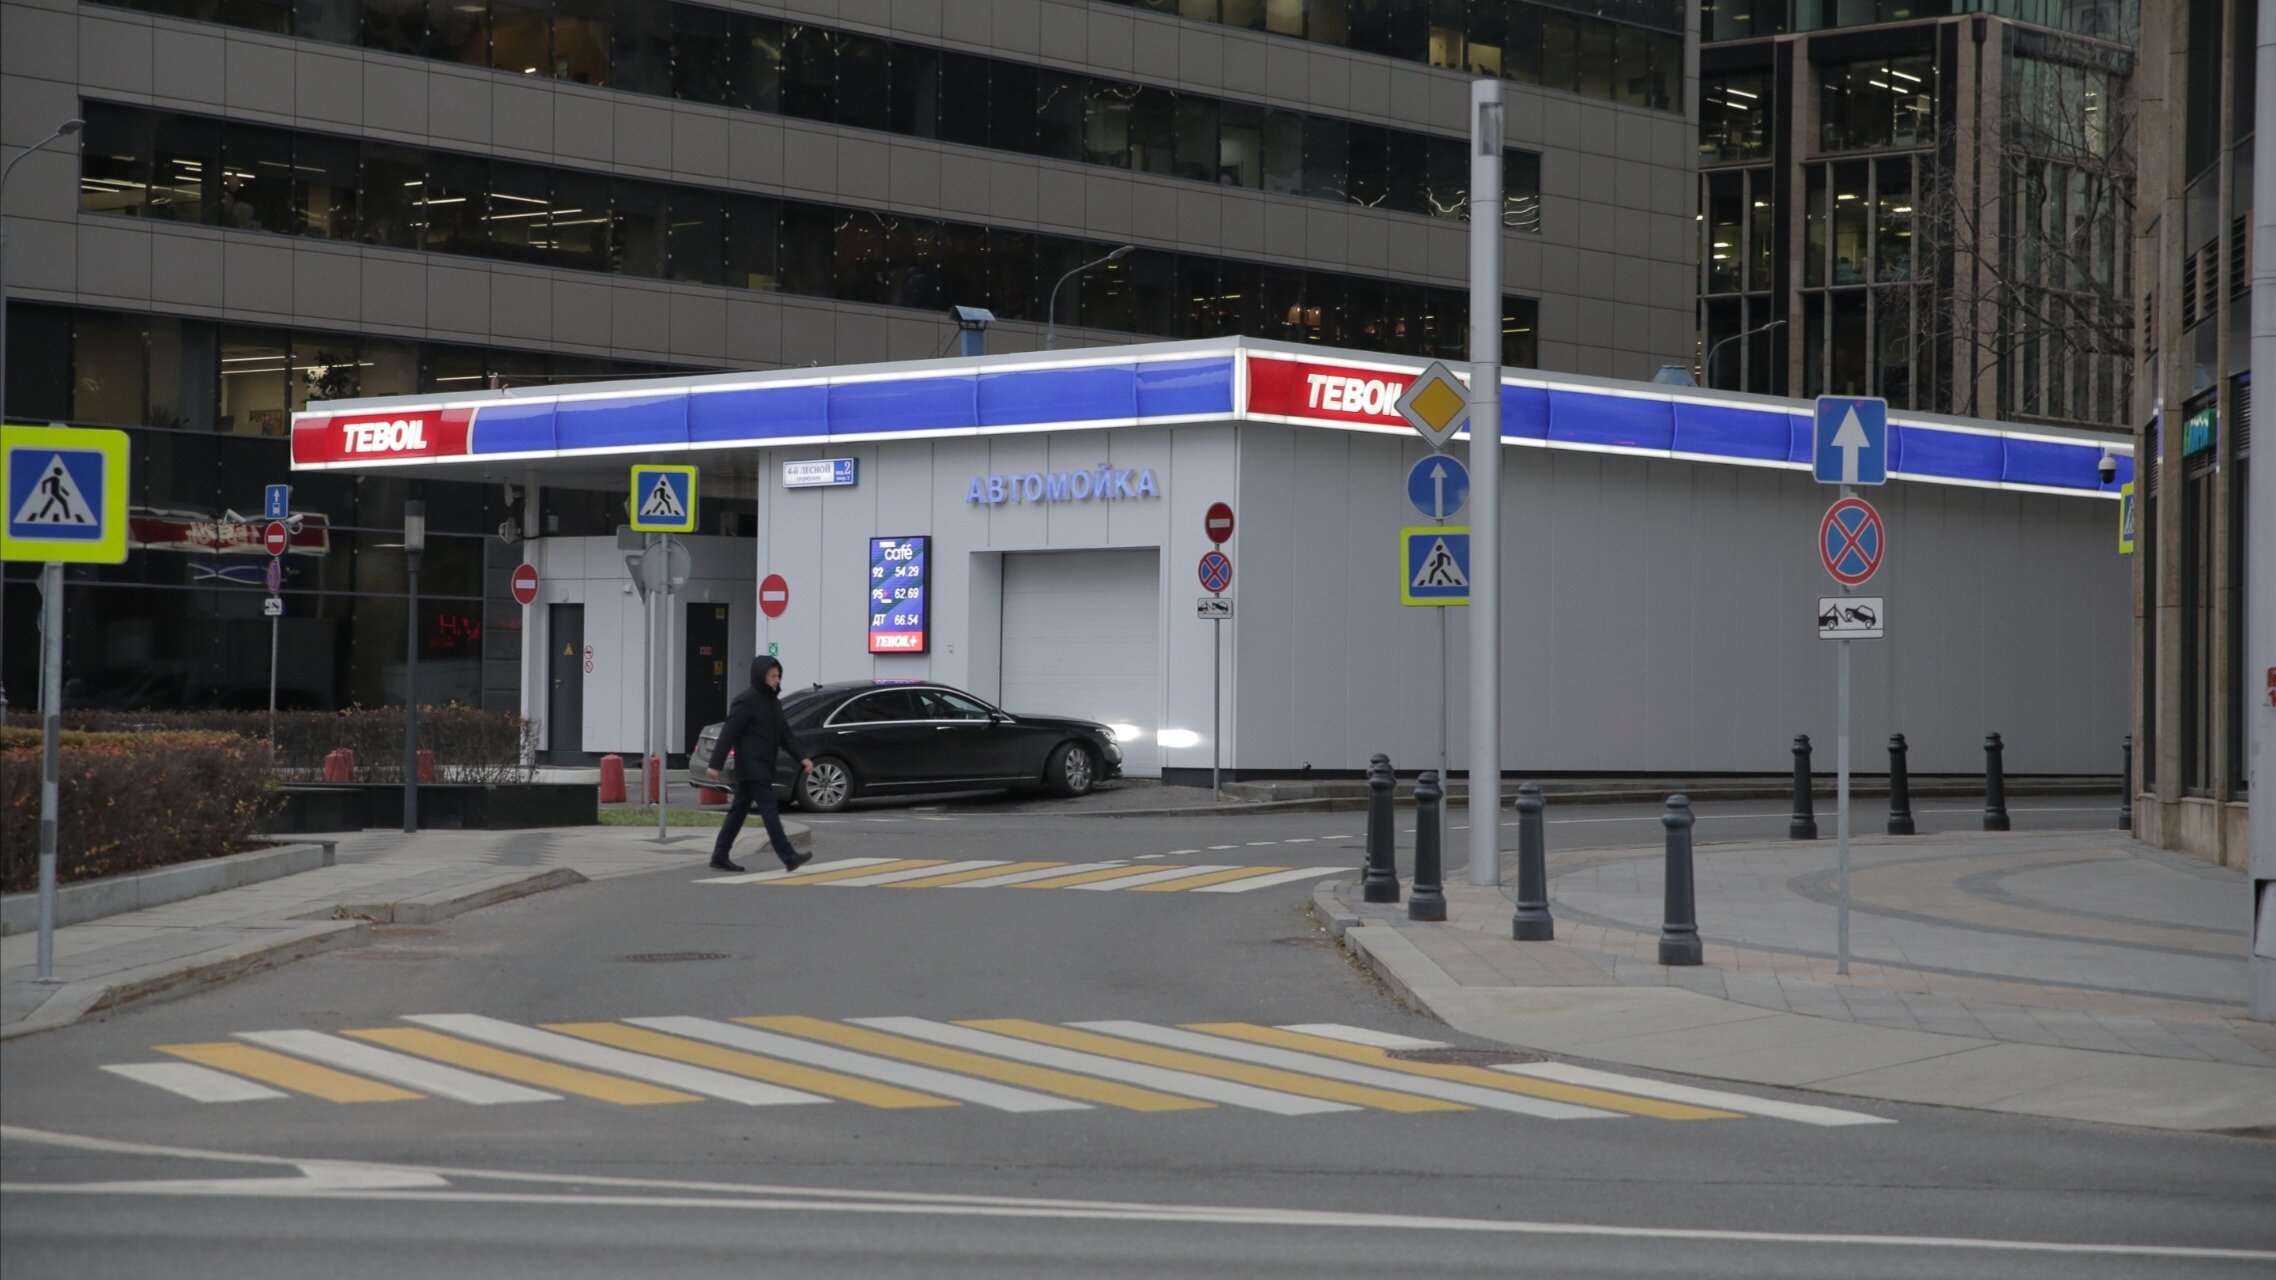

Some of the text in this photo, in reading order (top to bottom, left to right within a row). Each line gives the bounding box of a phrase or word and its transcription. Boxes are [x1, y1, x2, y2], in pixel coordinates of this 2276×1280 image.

[1307, 373, 1403, 417] TEBOIL
[343, 419, 428, 453] TEBOIL
[800, 464, 831, 475] ЛЕСНОЙ
[844, 461, 851, 475] 2
[966, 462, 1160, 505] АВТОМОЙКА
[884, 543, 913, 561] café
[872, 565, 919, 578] 92 54.29
[894, 587, 919, 599] 62.69
[872, 613, 919, 626] ДТ 66.54
